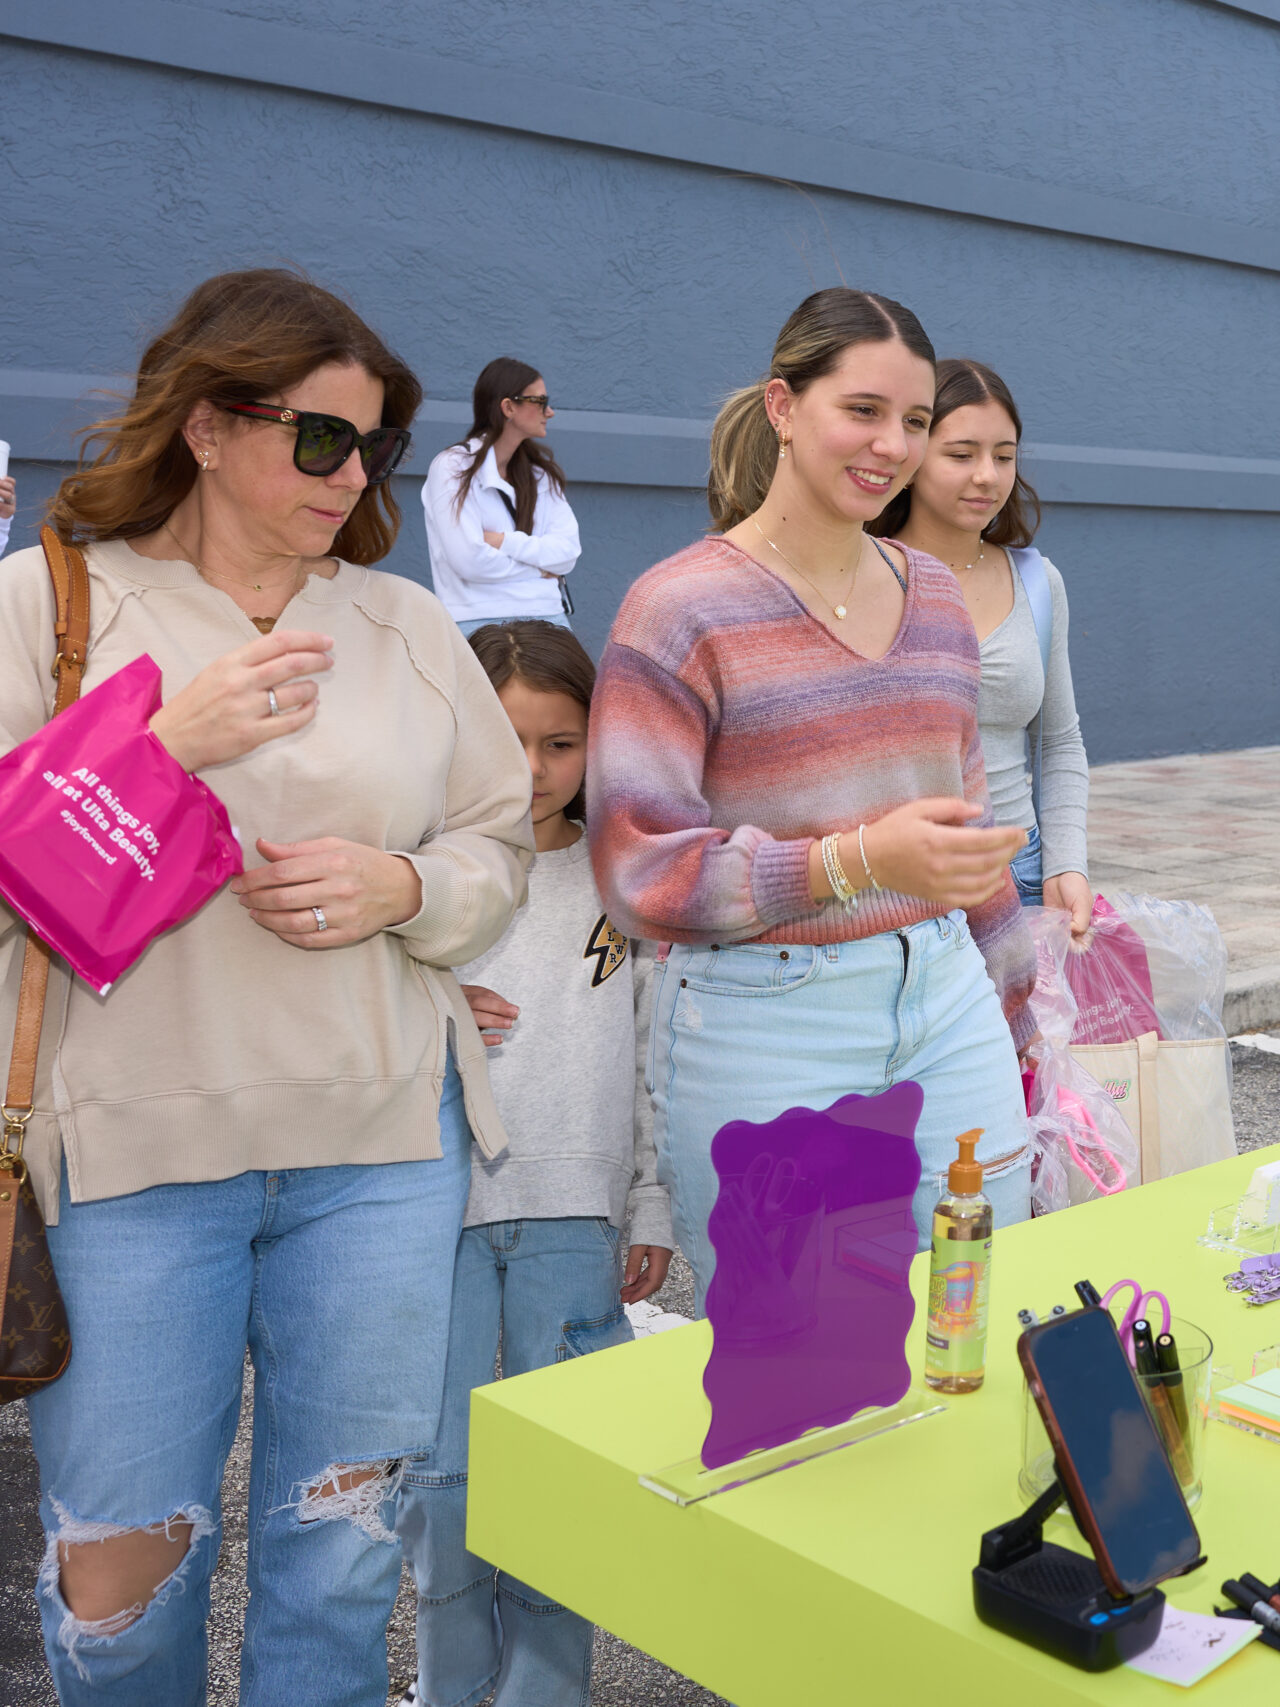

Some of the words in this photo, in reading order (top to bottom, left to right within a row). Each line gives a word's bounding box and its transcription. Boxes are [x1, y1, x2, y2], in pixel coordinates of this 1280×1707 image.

[42, 770, 67, 789] all
[62, 785, 83, 802] at
[80, 797, 110, 832] Ulta
[108, 827, 156, 881] Beauty.
[71, 767, 101, 788] All
[95, 784, 140, 829] things
[133, 822, 161, 855] joy,
